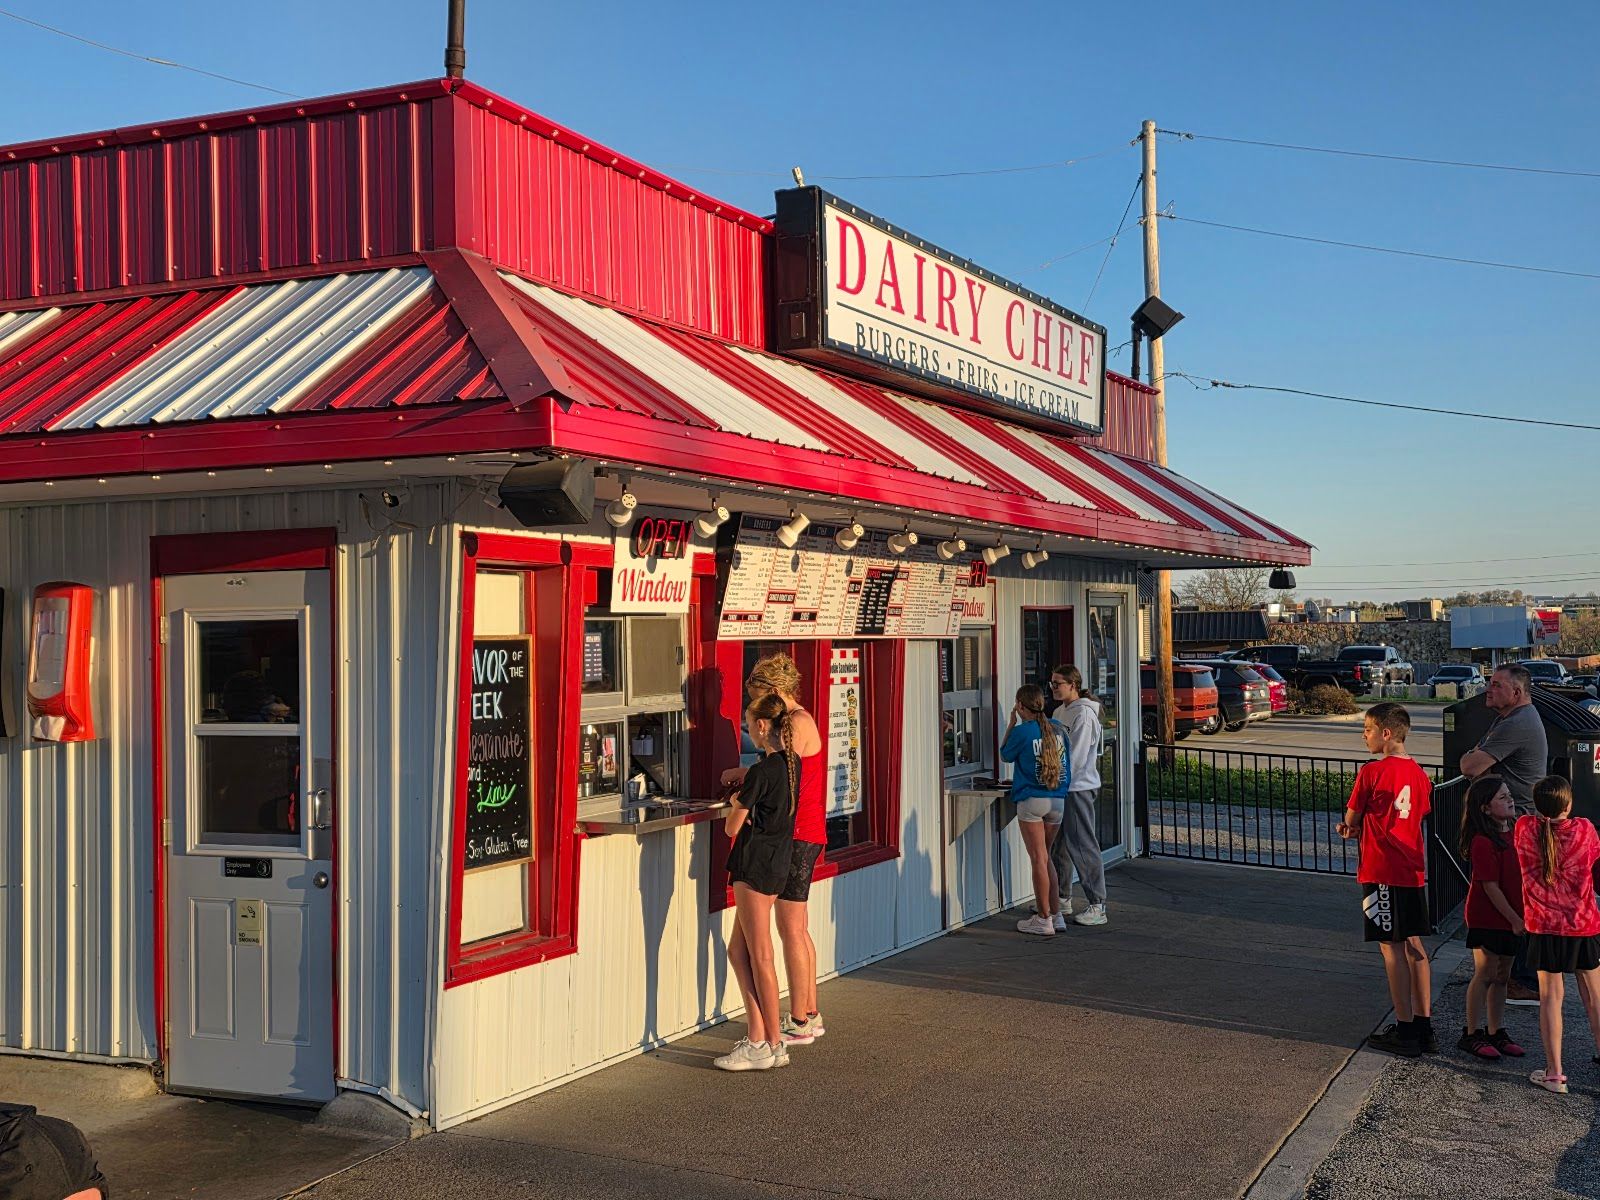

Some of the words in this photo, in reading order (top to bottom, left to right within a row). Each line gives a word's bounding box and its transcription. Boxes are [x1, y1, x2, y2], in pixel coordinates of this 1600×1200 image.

[835, 215, 986, 345] DAIRY
[1005, 299, 1094, 386] CHEF
[855, 322, 940, 374] BURGERS
[957, 358, 999, 394] FRIES
[1013, 380, 1034, 407] ICE
[1039, 389, 1080, 421] CREAM
[637, 517, 693, 558] OPEN
[618, 567, 687, 602] Window
[968, 561, 989, 587] PEN
[963, 597, 985, 618] ndow
[512, 650, 524, 661] OF
[509, 666, 524, 678] THE
[472, 691, 503, 720] EEK
[470, 730, 523, 762] egranate
[477, 781, 517, 813] Lime
[1394, 785, 1412, 820] 4
[226, 861, 251, 869] Employees
[226, 868, 237, 876] Only
[1378, 883, 1393, 932] adidas
